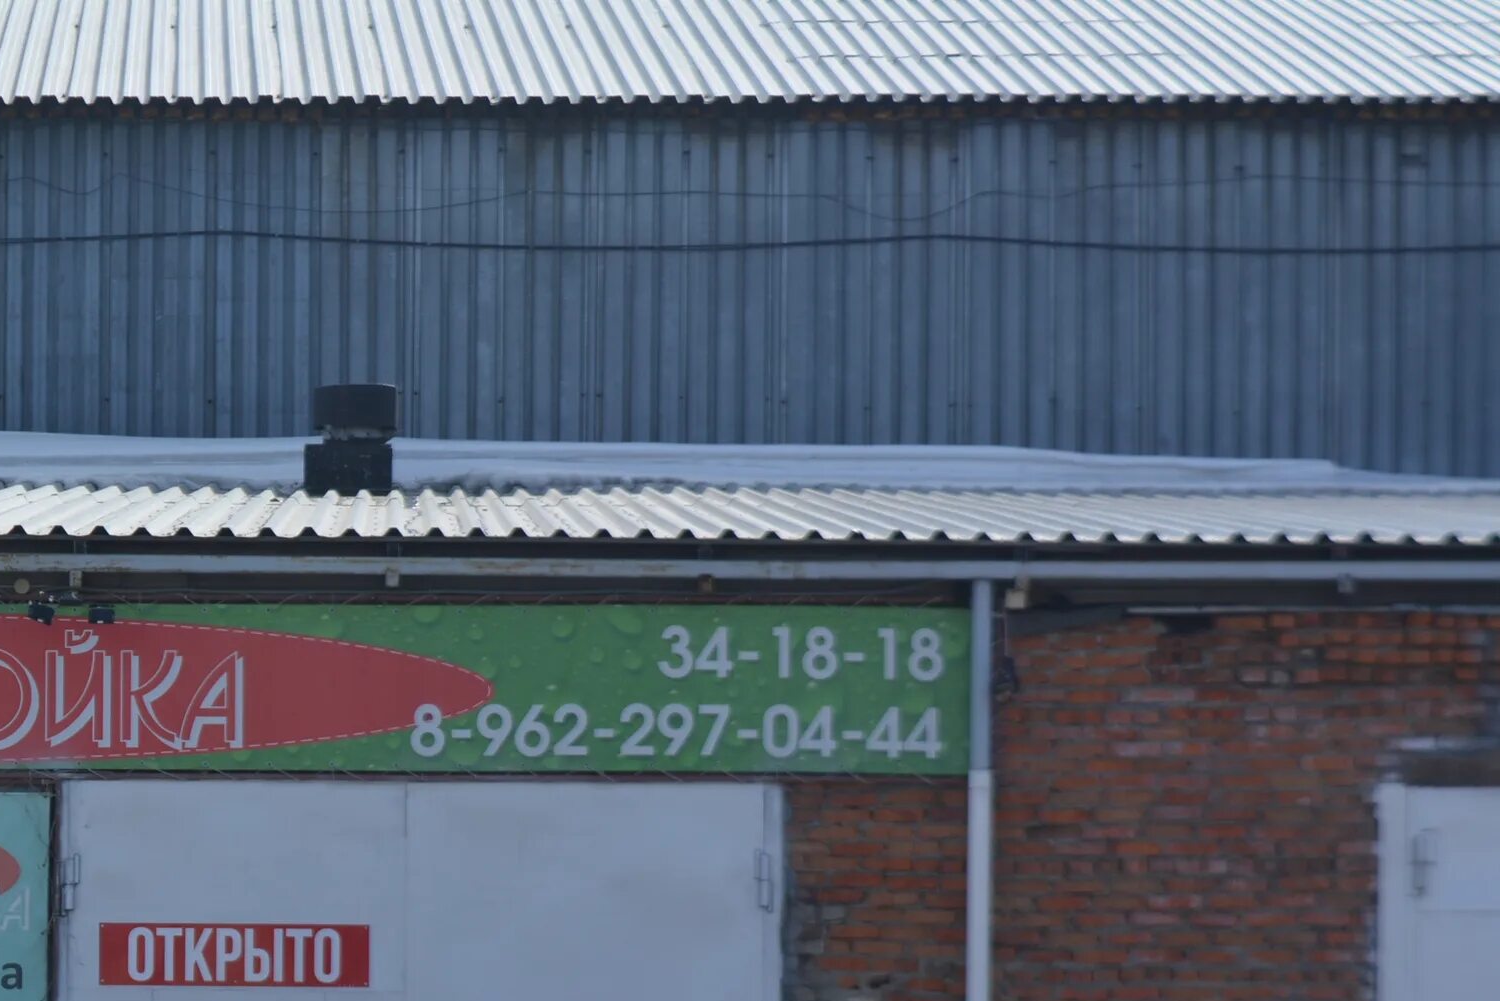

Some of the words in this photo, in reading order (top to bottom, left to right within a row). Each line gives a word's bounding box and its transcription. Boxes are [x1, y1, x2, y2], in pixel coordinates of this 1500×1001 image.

[658, 624, 944, 682] 34-18-18
[410, 703, 944, 758] 8-962-297-04-44
[127, 927, 341, 983] ОТКРЫТО
